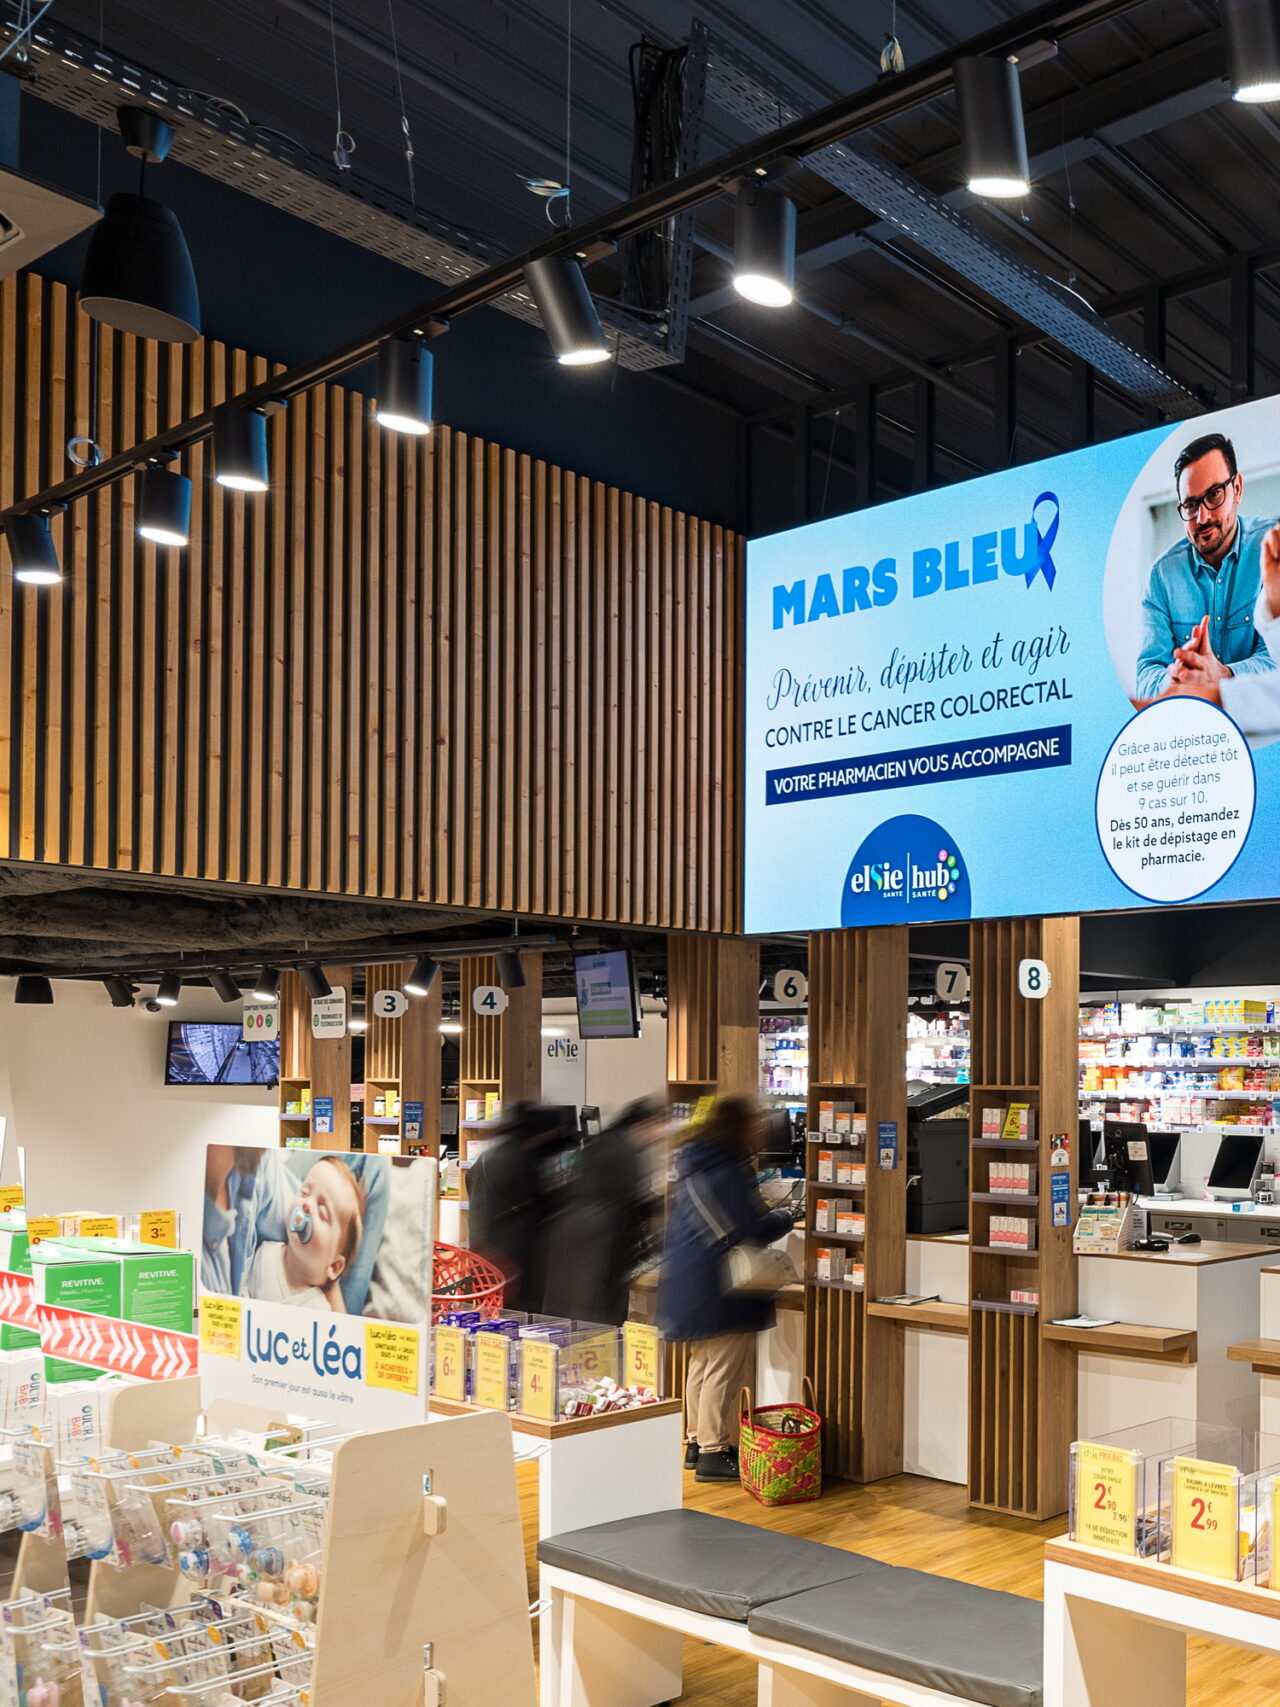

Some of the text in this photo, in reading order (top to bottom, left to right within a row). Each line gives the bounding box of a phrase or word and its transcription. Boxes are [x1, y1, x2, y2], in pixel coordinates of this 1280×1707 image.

[772, 522, 1039, 629] MARS BLEU
[767, 625, 1070, 710] Prévenir, dépister et agir
[765, 678, 1072, 748] CONTRE LE CANCER COLORECTAL
[1118, 733, 1230, 756] Grâce au dépistage,
[775, 739, 1059, 794] VOTRE PHARMACIEN VOUS ACCOMPAGNE
[1112, 749, 1238, 778] il peut être détecté tôt
[1127, 771, 1220, 792] et se guérir dans
[1139, 791, 1207, 809] 9 cas sur 10.
[1111, 807, 1239, 831] Dès 50 ans, demandez
[1113, 830, 1236, 849] le kit de dépistage en
[1141, 850, 1204, 869] pharmacie.
[912, 863, 949, 888] hub
[912, 890, 936, 898] SANTÉ
[783, 976, 796, 998] 6
[944, 971, 958, 994] 7
[1027, 967, 1041, 990] 8
[383, 996, 396, 1012] 3
[481, 992, 496, 1009] 4
[247, 1310, 289, 1365] luc
[293, 1338, 310, 1360] et
[313, 1322, 362, 1379] léa
